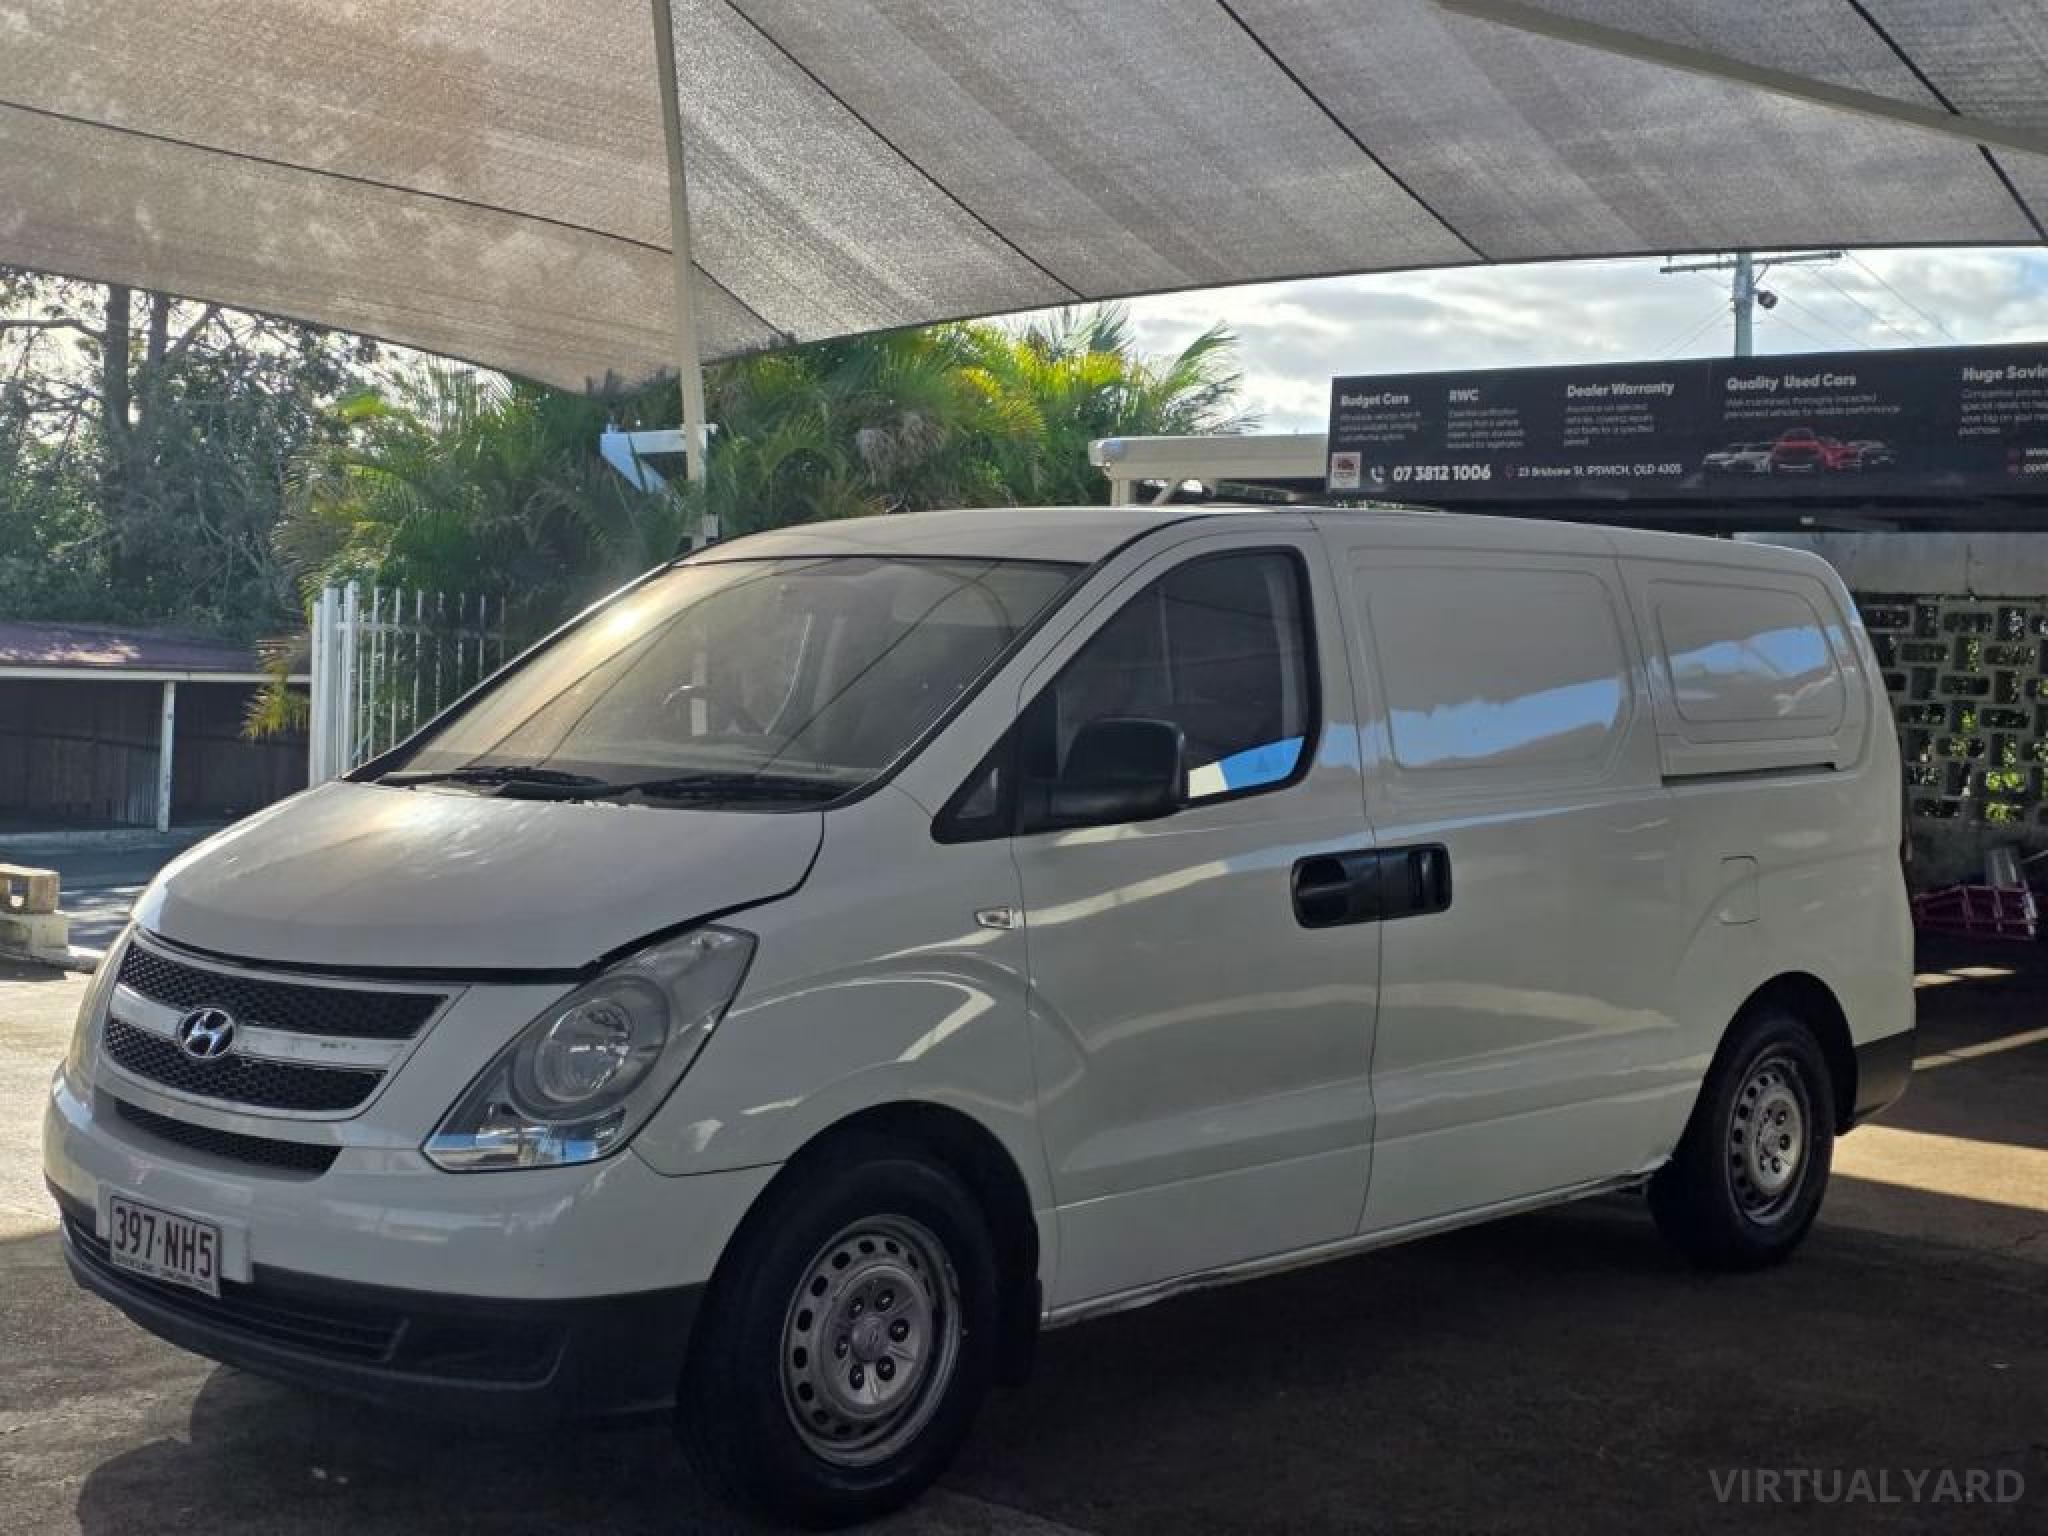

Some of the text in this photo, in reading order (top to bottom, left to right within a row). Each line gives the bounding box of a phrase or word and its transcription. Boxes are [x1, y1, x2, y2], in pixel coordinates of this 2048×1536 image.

[1961, 367, 2004, 383] Huge
[1567, 383, 1675, 397] Dealer Warranty
[1727, 374, 1857, 392] Quality Used Cars
[1341, 393, 1410, 408] Budget Cars
[1449, 389, 1480, 402] RWC
[1393, 464, 1491, 481] 07 3812 1006
[1531, 466, 1571, 477] Brisbane
[1633, 463, 1654, 477] QLD
